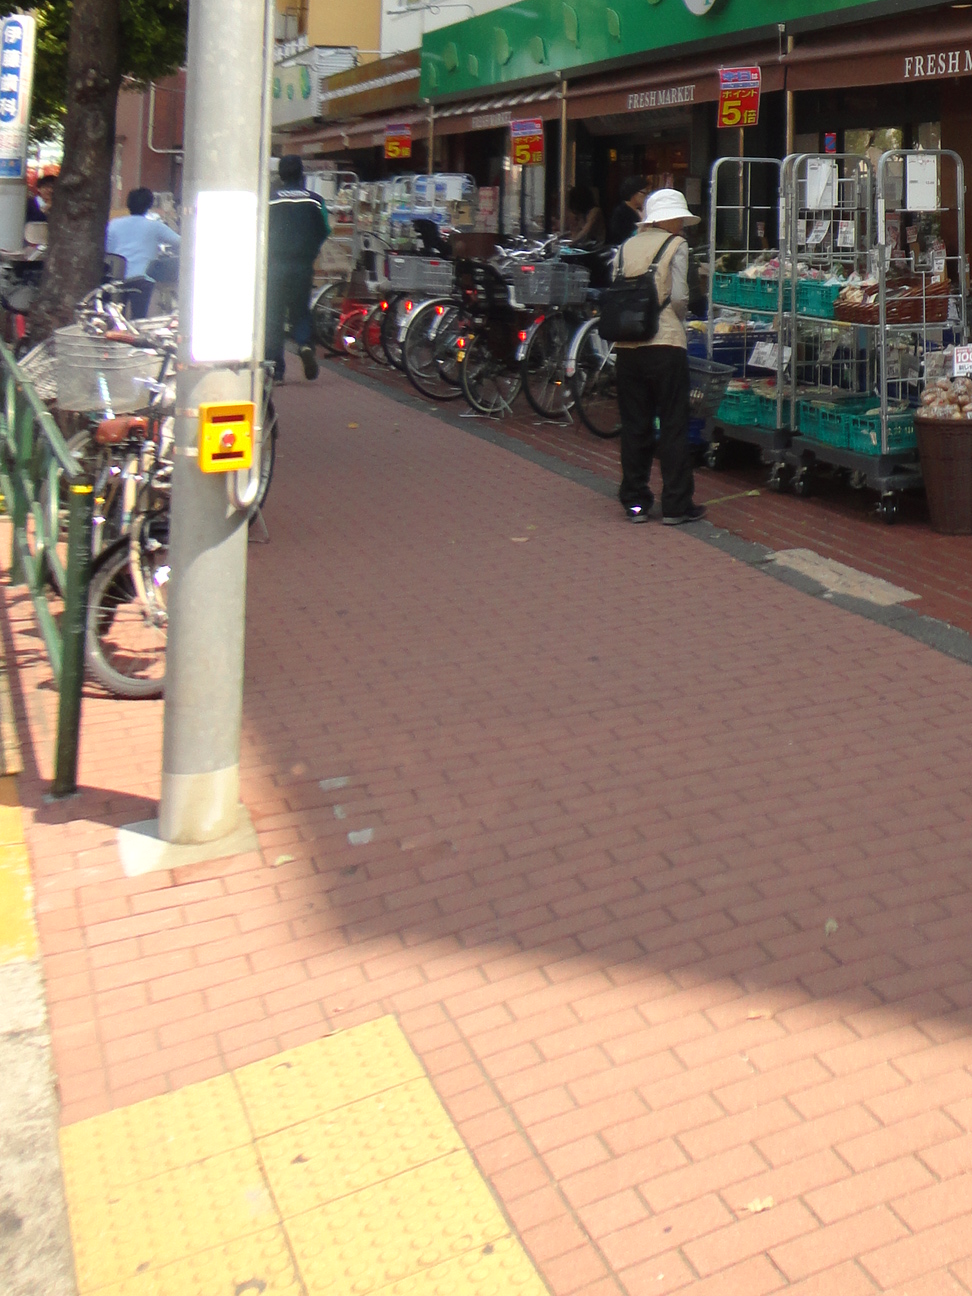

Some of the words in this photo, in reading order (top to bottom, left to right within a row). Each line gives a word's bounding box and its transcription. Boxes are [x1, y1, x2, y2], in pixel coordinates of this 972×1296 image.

[904, 50, 961, 78] FRESH
[627, 91, 657, 110] FRESH
[657, 84, 696, 106] MARKET
[721, 89, 759, 99] ポイント
[721, 100, 757, 126] 5倍
